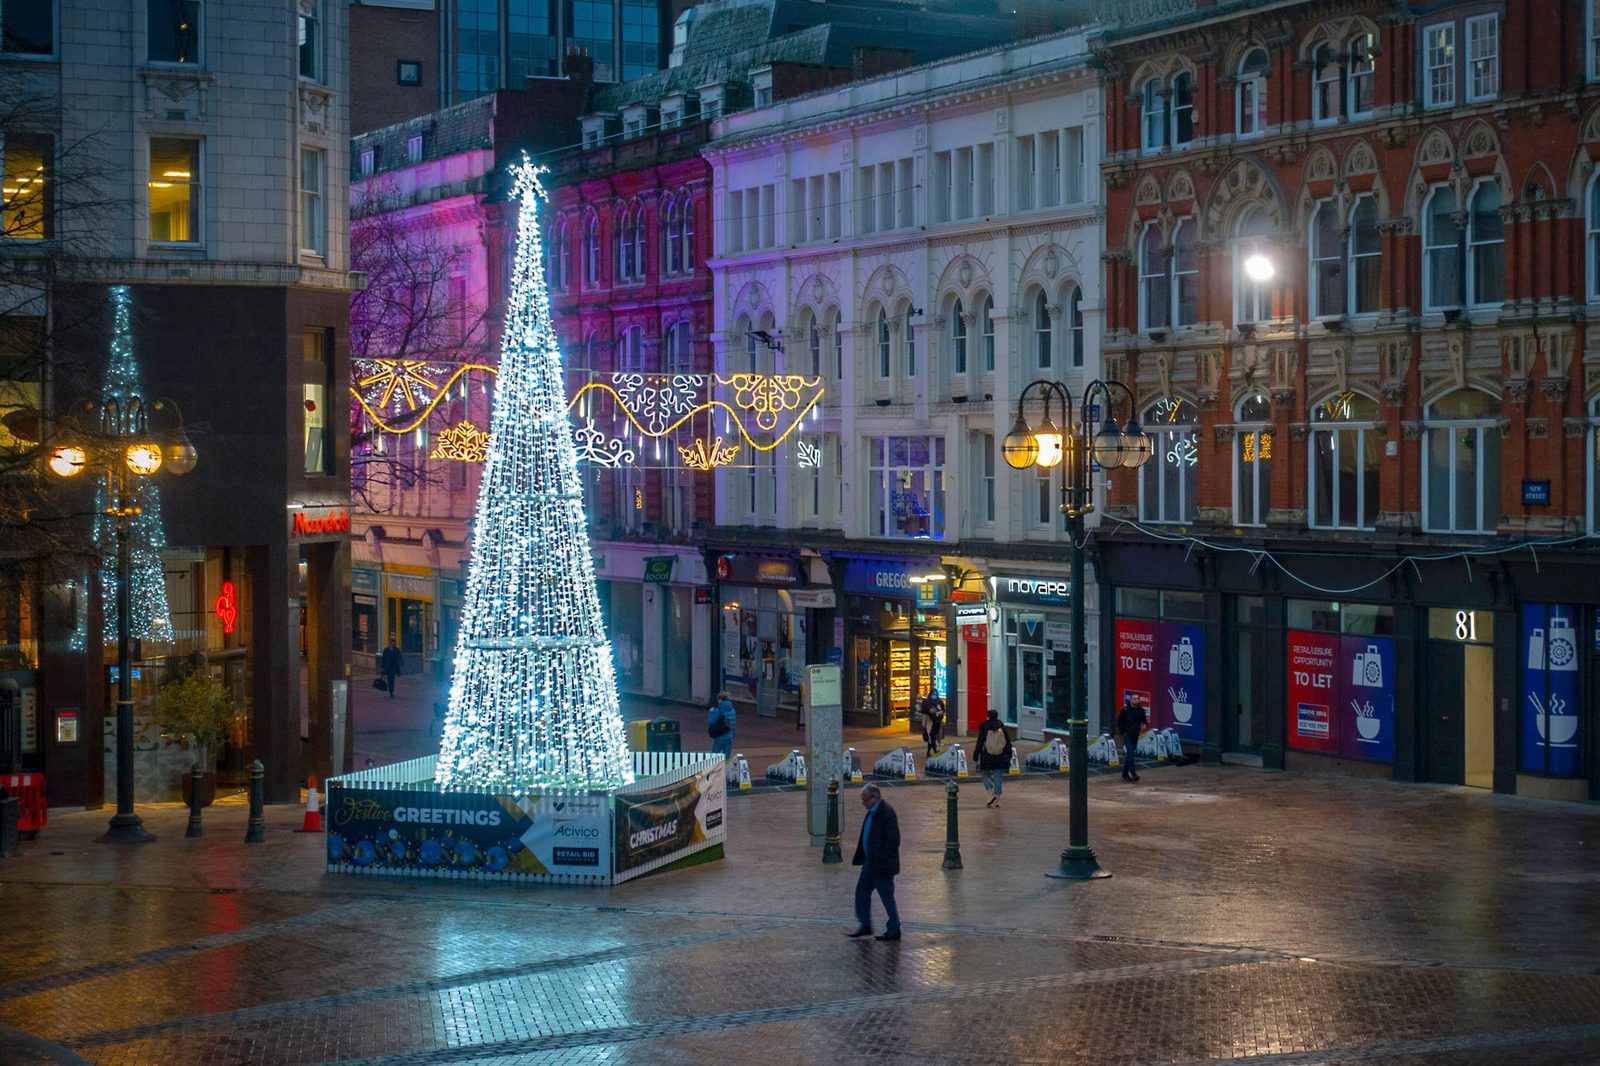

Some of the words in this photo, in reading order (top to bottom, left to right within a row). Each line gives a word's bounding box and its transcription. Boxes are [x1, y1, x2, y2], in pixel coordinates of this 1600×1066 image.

[1456, 611, 1476, 640] 81
[1120, 642, 1153, 652] OPPORTUNITY
[1120, 656, 1134, 669] TO
[1136, 657, 1153, 671] LET
[1294, 656, 1333, 666] OPPORTUNITY
[1294, 671, 1309, 686] TO
[1312, 673, 1333, 688] LET
[335, 797, 390, 825] Festive
[393, 807, 501, 826] GREETINGS
[553, 825, 599, 837] Acivico
[630, 819, 678, 848] CHRISTMAS
